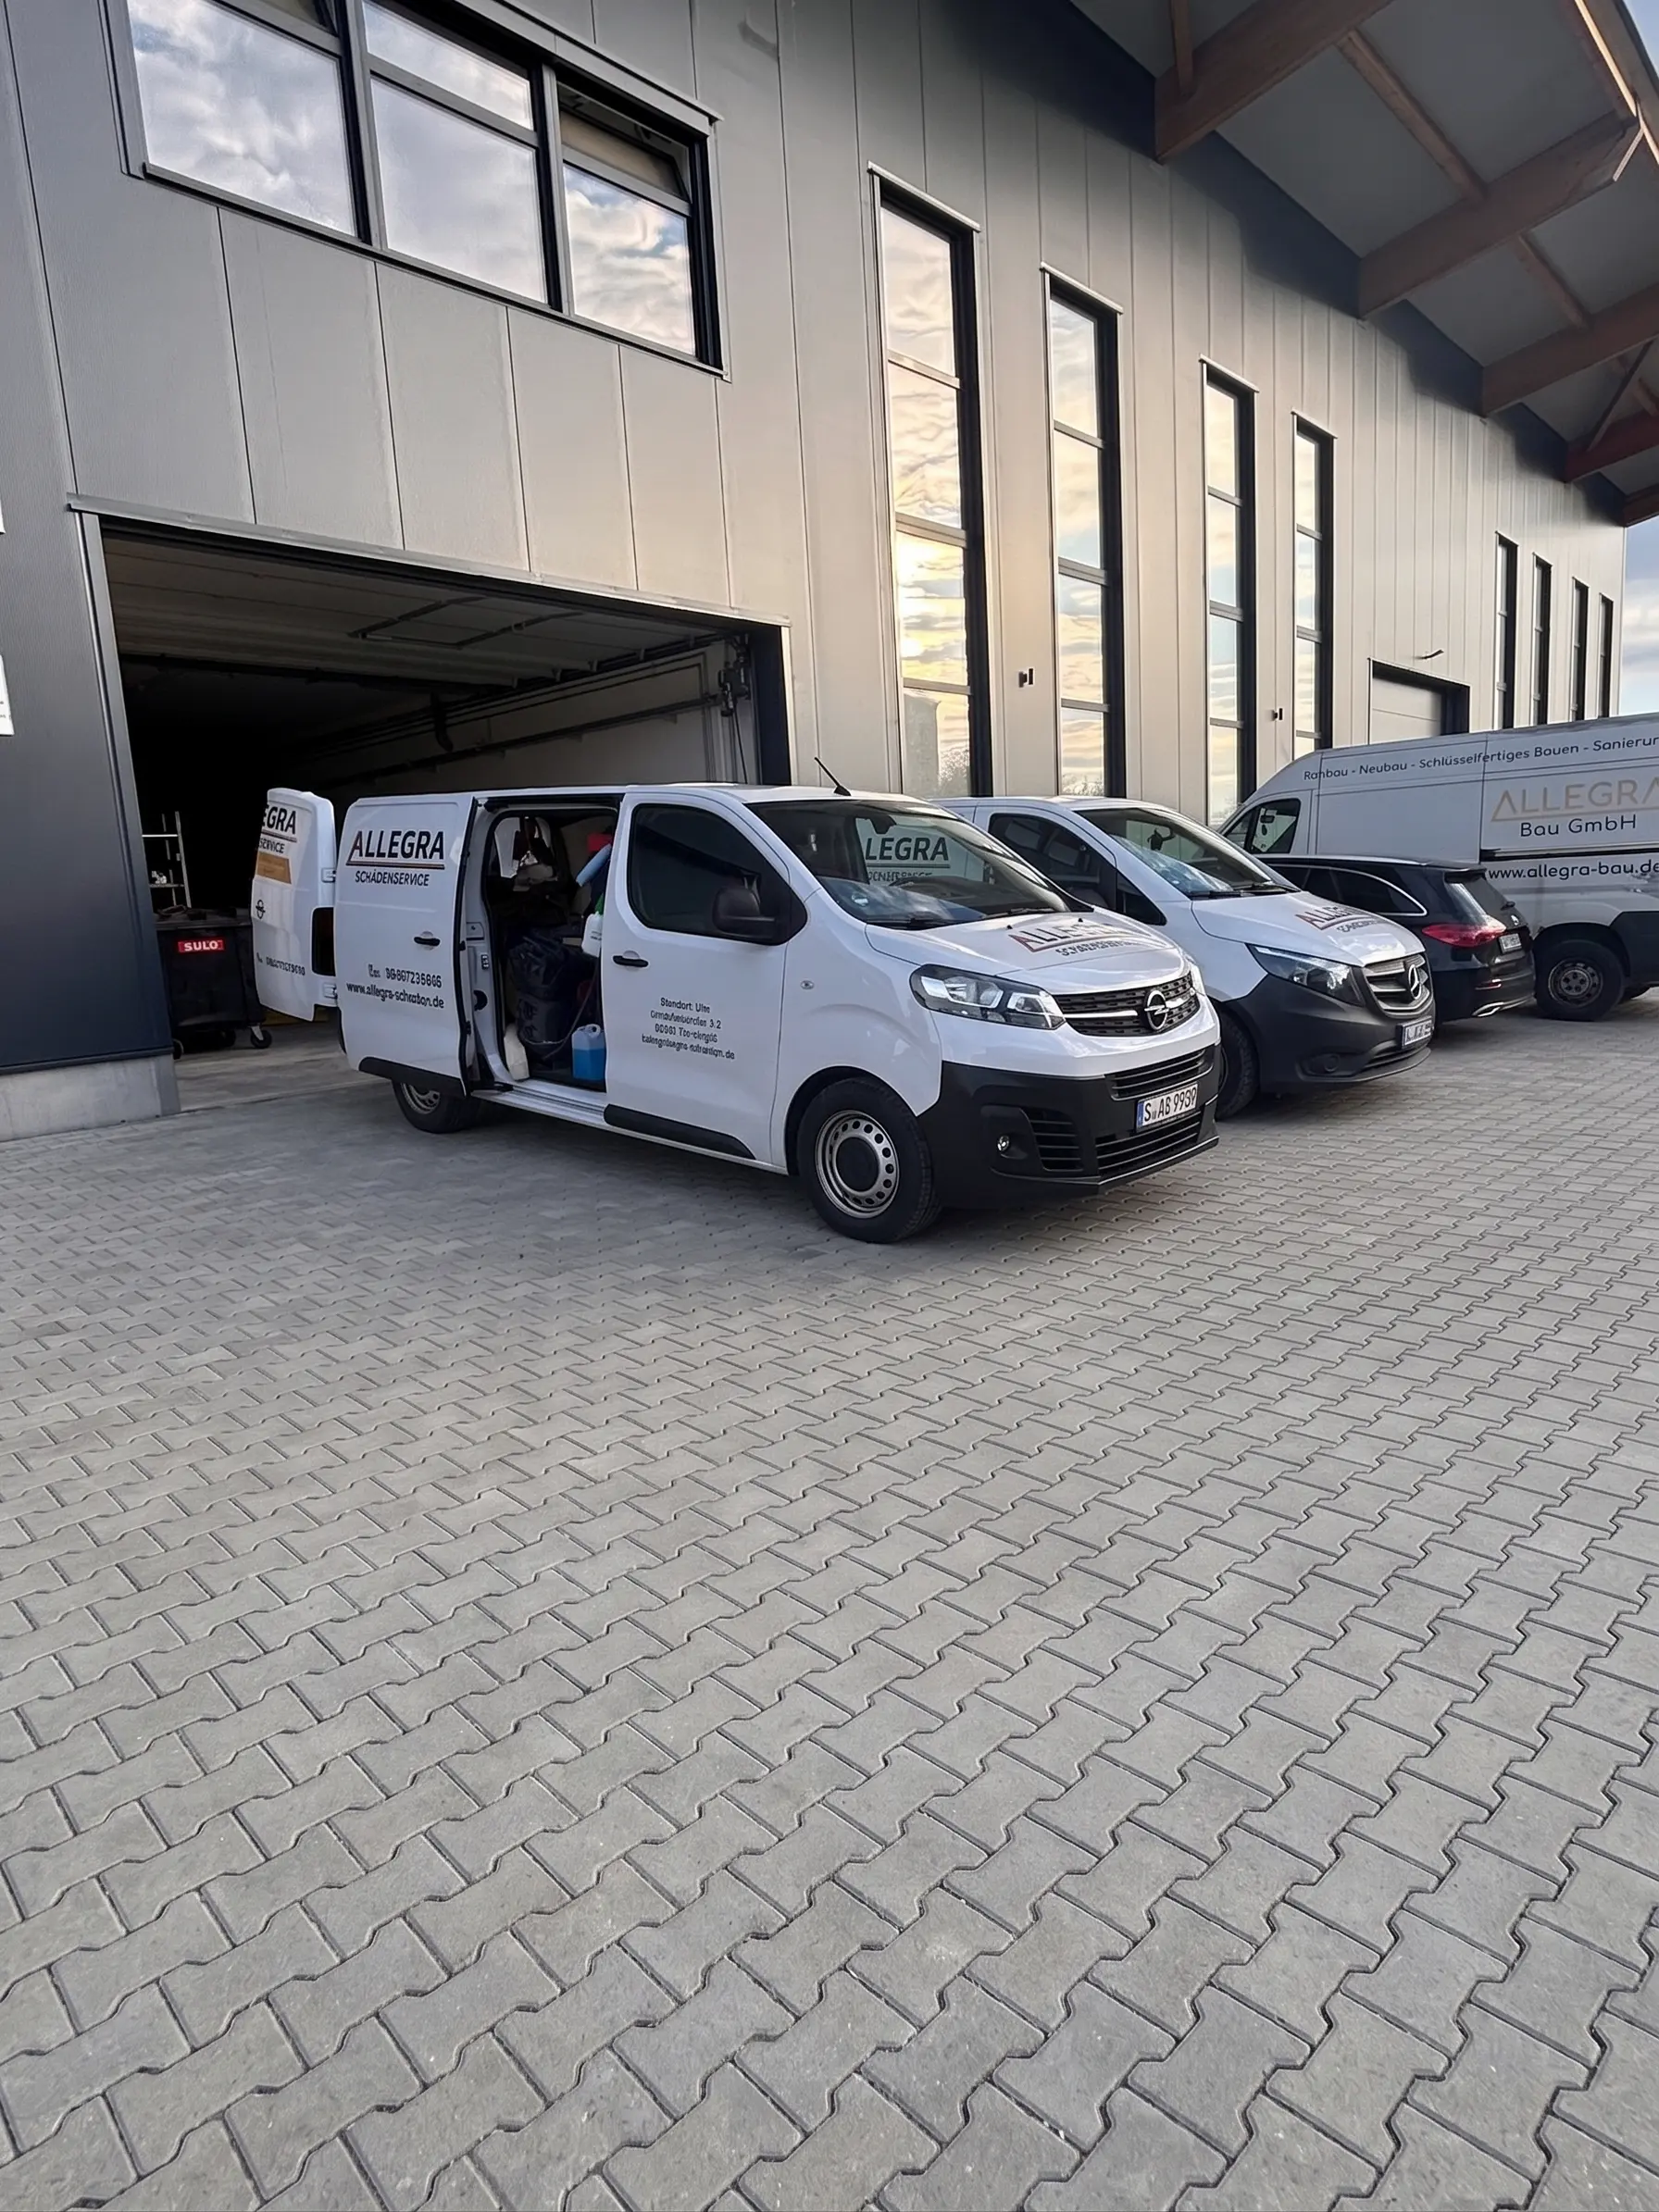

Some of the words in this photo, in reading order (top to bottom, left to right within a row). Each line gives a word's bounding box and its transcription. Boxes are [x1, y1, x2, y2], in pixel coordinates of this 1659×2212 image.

[1359, 762, 1407, 775] Neubau
[1419, 751, 1529, 768] Schlüsselfertiges
[1534, 745, 1578, 758] Bauen
[1520, 822, 1559, 838] Bau
[1568, 814, 1636, 834] GmbH
[346, 830, 444, 867] ALLEGRA
[1489, 859, 1659, 880] www.allegra-bau.de
[183, 940, 218, 951] SULO
